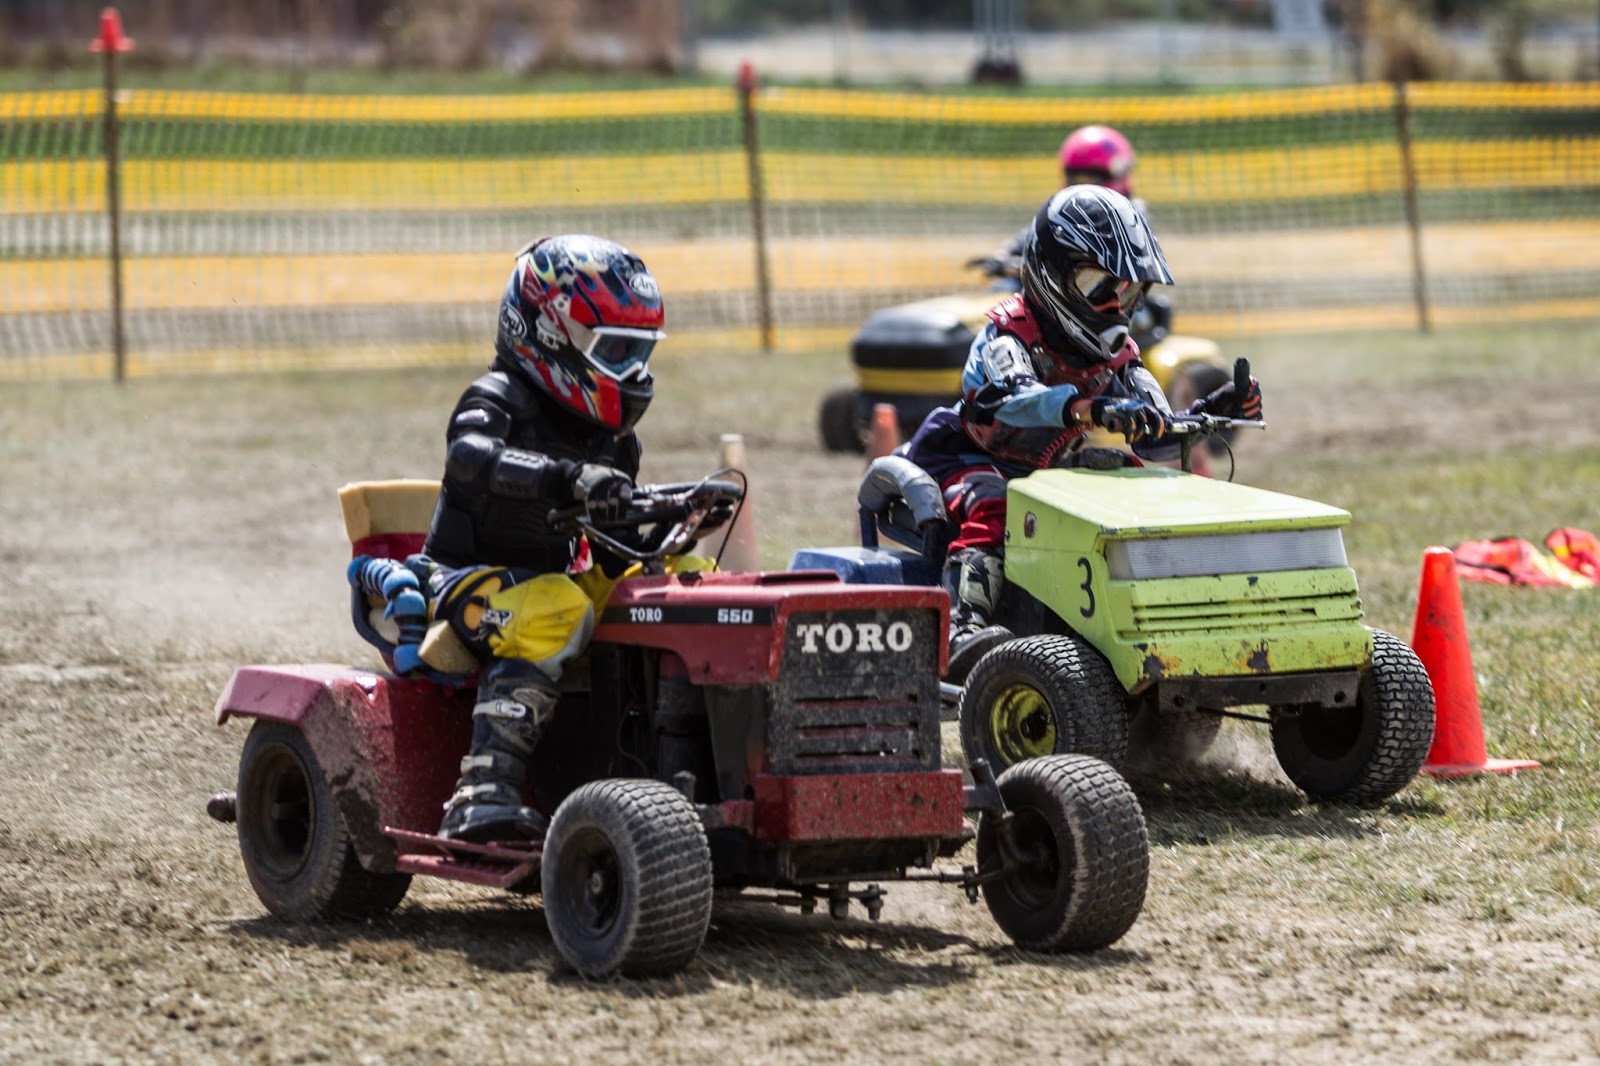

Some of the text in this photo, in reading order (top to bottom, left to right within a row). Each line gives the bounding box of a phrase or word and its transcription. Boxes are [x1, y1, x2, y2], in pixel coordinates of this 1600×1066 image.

[1077, 557, 1095, 618] 3
[630, 607, 753, 623] TORO 550
[796, 622, 913, 654] TORO
